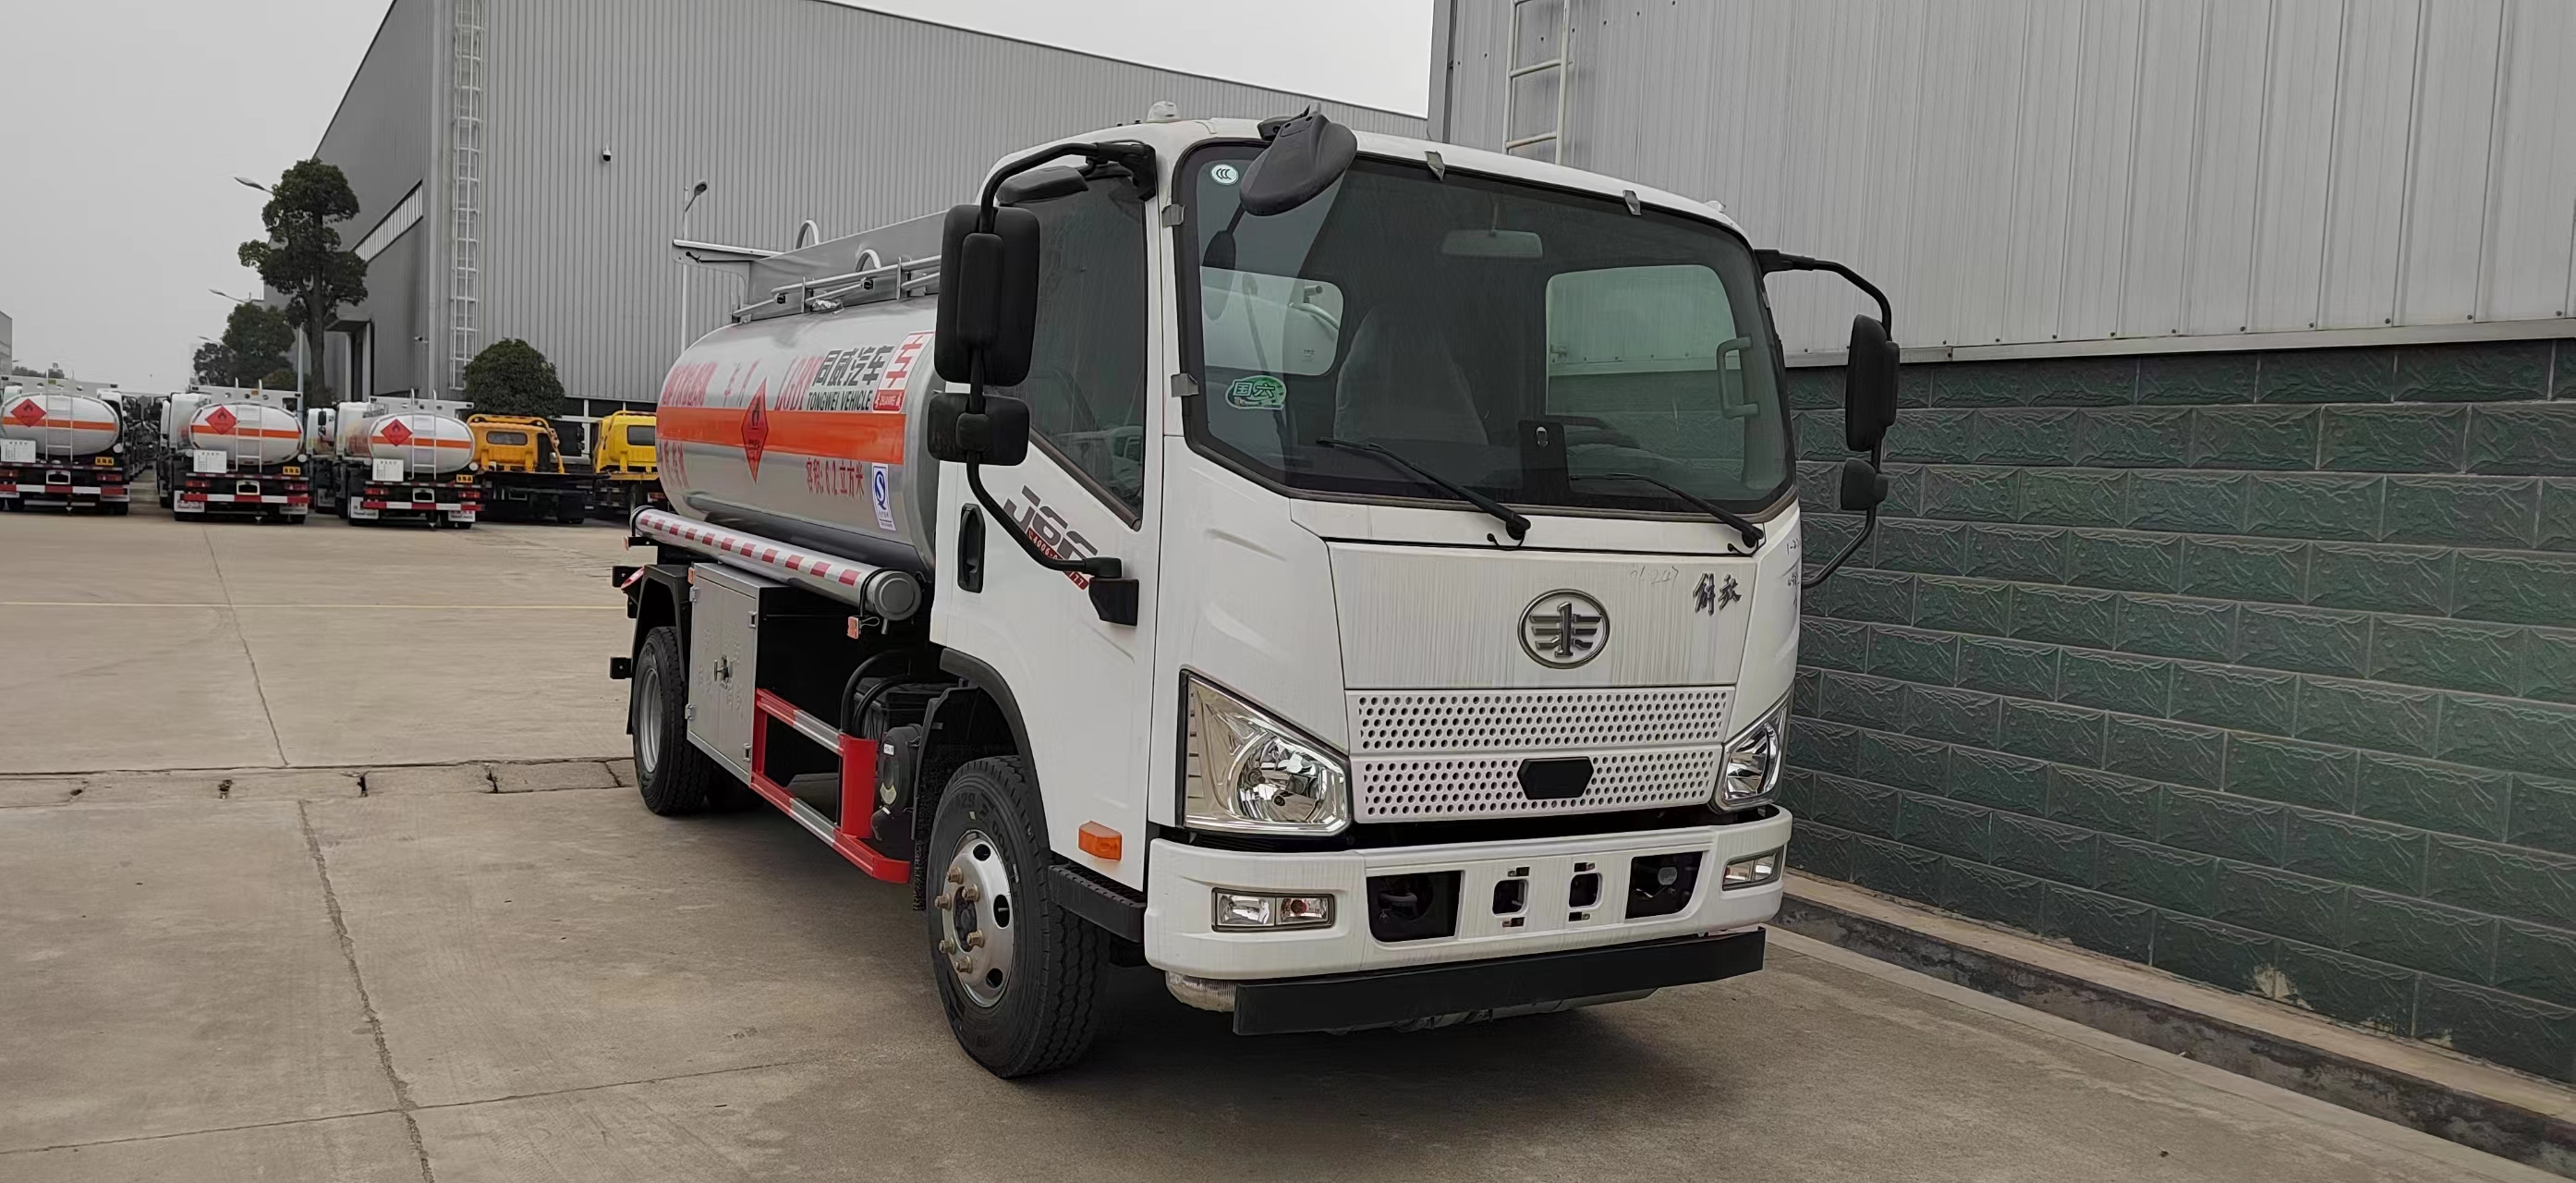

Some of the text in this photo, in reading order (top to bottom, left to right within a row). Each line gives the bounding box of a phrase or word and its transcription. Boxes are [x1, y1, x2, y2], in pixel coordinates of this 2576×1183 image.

[806, 391, 840, 410] TONGWEI
[840, 389, 873, 410] VEHICLE
[1233, 382, 1275, 398] 国六
[1693, 573, 1743, 616] 解放
